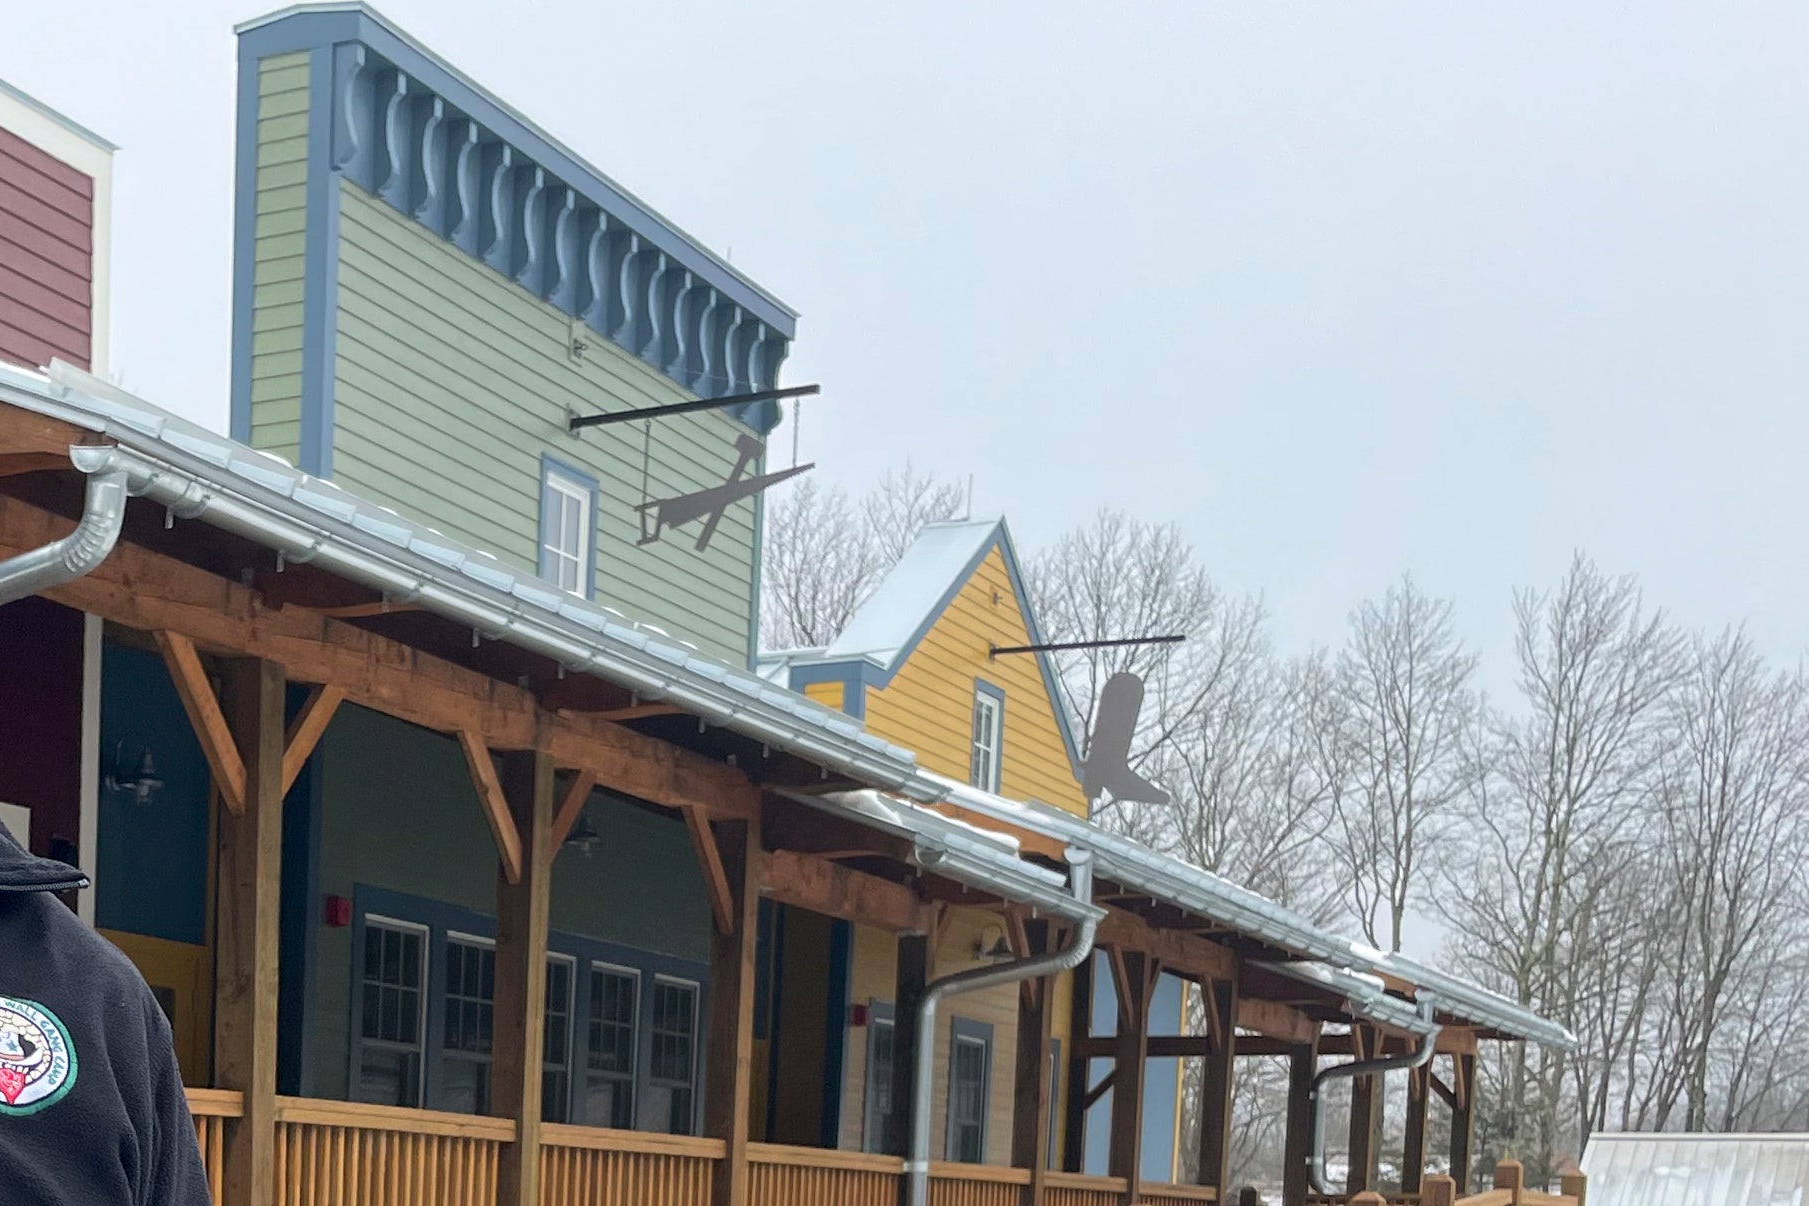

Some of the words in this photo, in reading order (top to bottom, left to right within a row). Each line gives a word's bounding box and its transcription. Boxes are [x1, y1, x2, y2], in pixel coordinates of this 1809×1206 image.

[5, 1000, 37, 1020] WALL
[40, 1020, 63, 1052] GANG
[47, 1056, 65, 1084] CAMP
